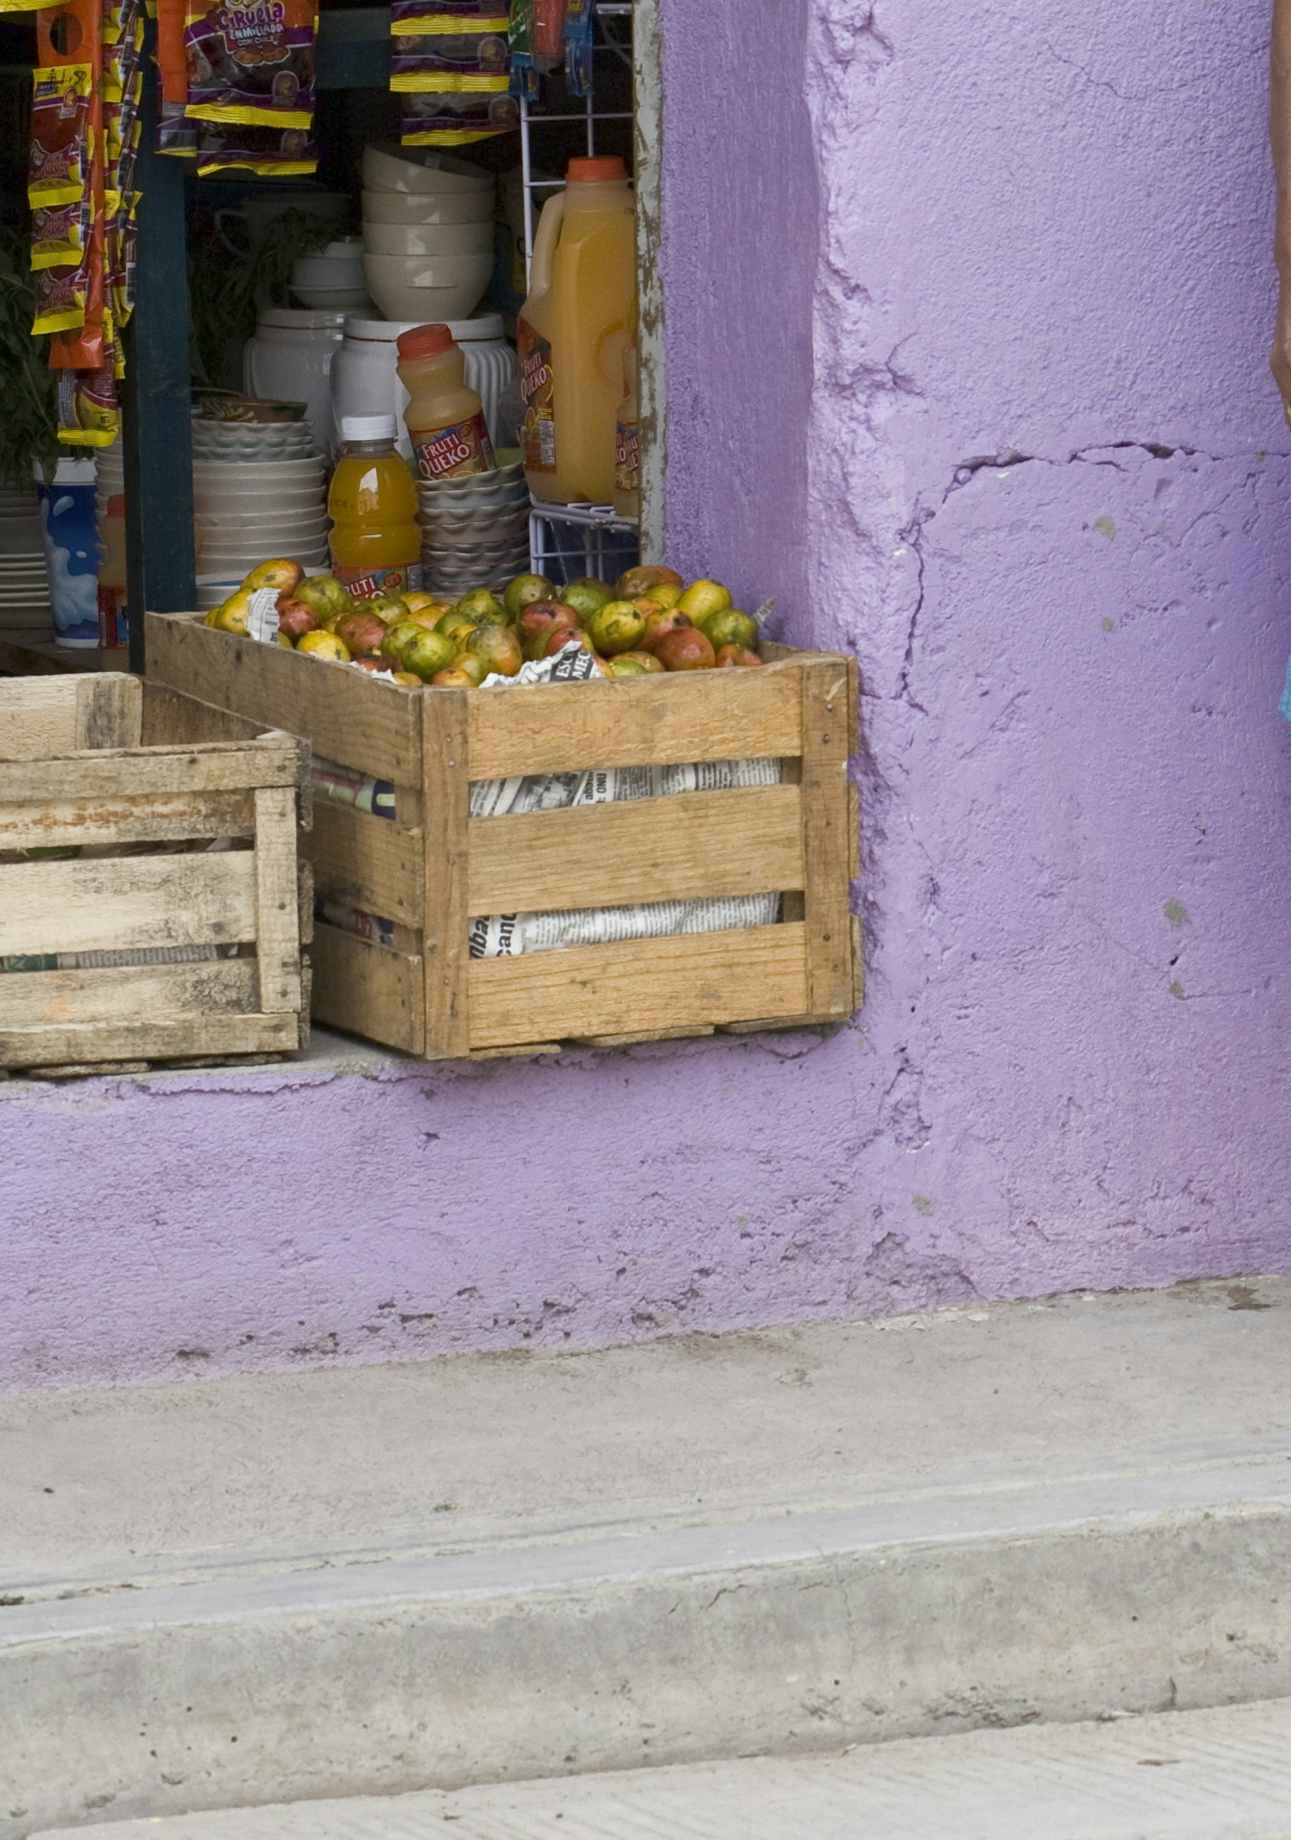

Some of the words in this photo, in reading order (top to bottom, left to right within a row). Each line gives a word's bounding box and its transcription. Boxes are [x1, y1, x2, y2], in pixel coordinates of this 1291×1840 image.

[421, 433, 460, 460] FRUTI
[419, 443, 470, 480] QUEKO
[343, 576, 376, 596] RUTI
